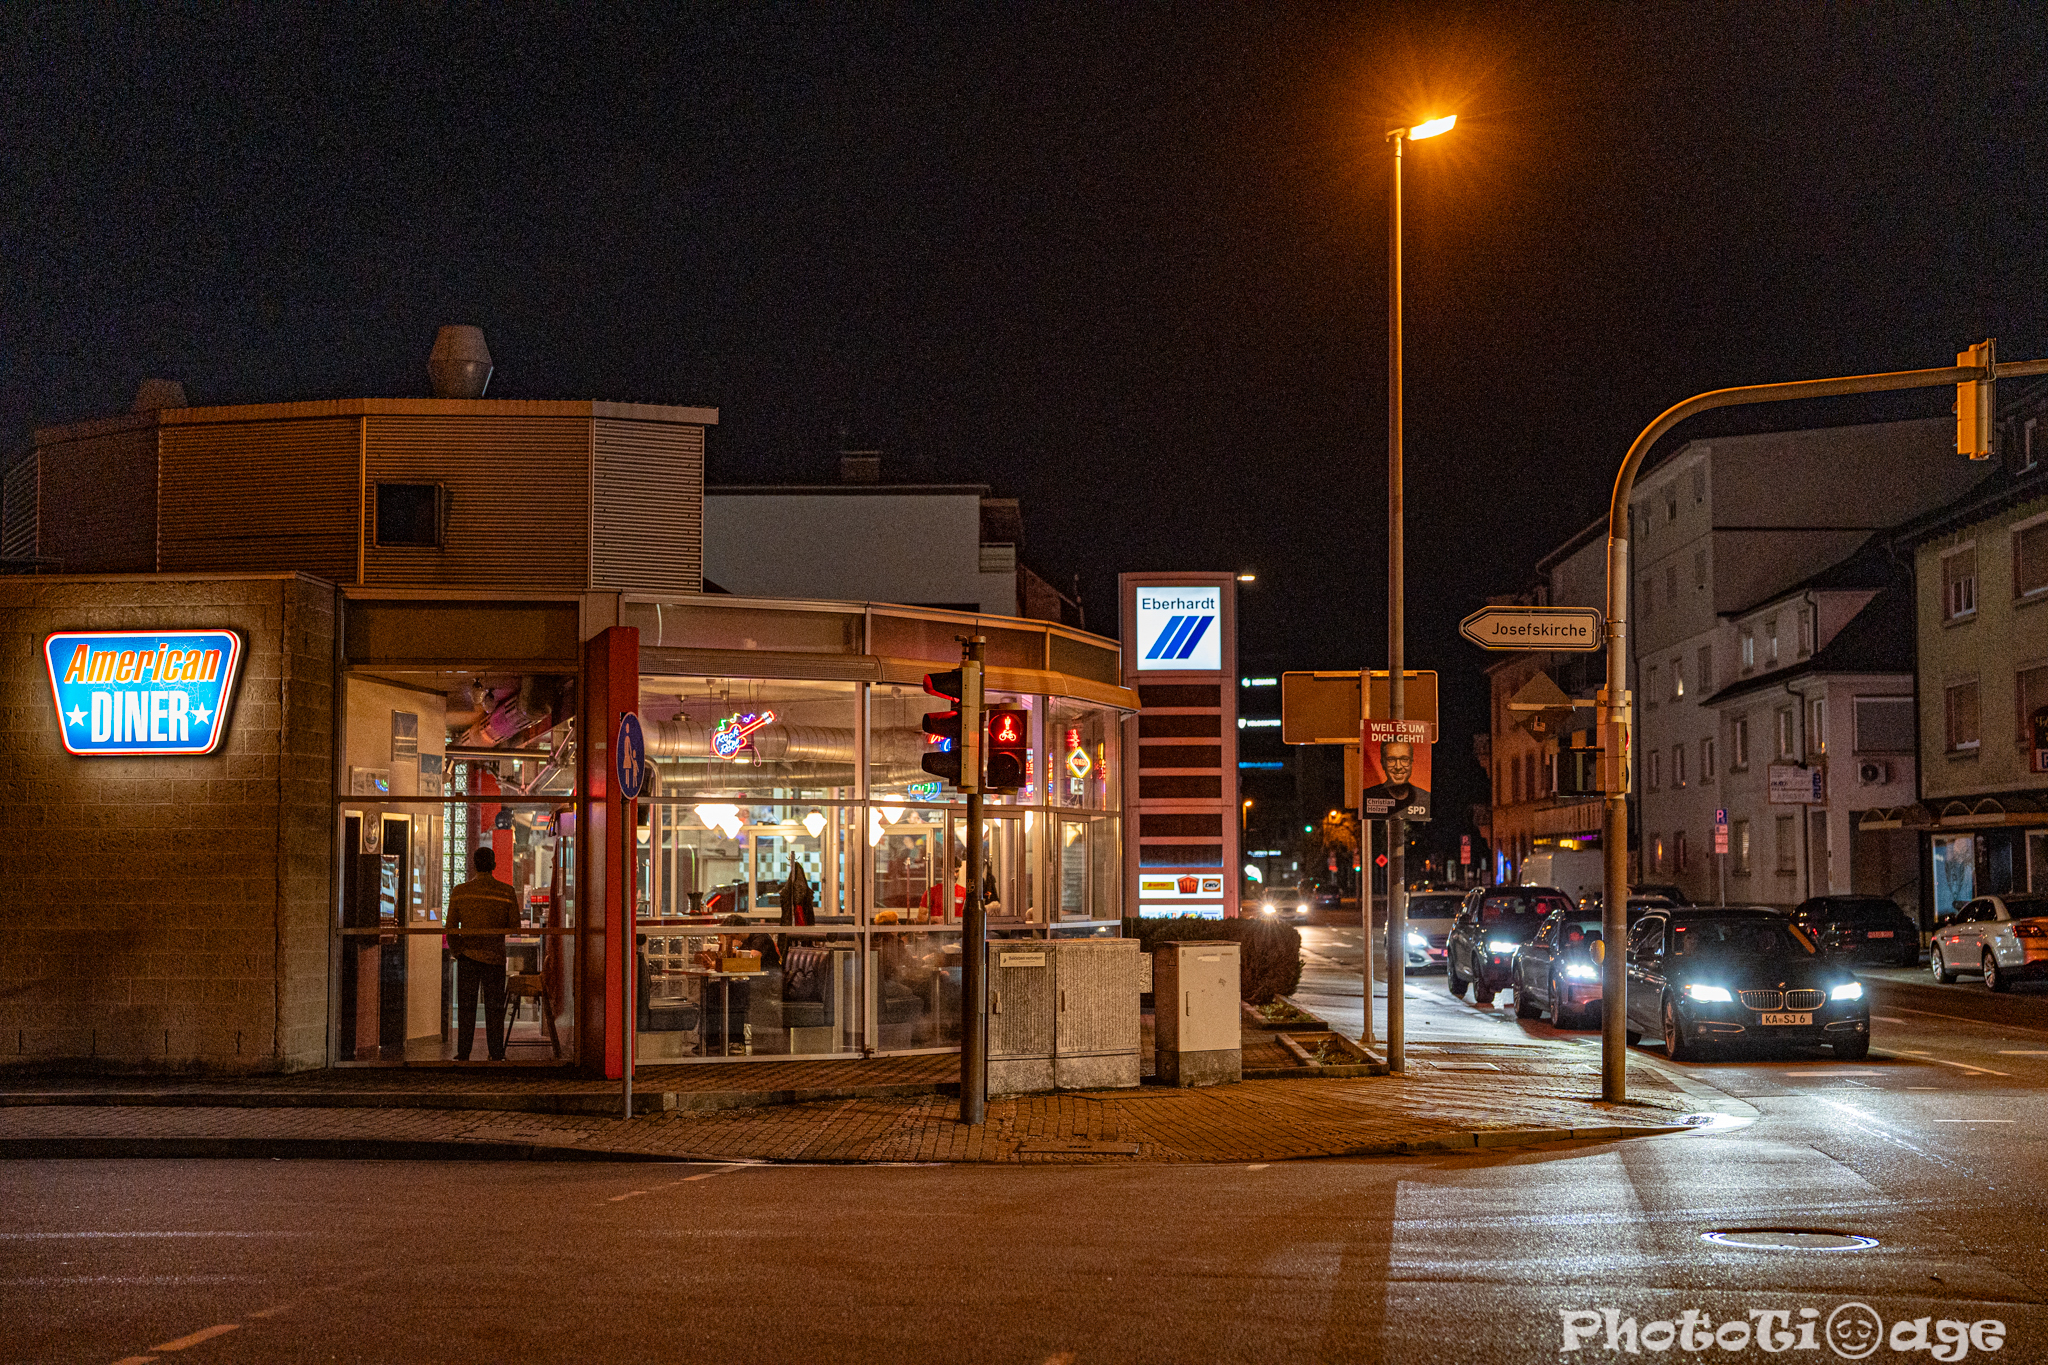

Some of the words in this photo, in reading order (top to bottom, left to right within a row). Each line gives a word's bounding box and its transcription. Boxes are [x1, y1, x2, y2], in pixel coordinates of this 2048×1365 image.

[1142, 597, 1215, 610] Eberhardt
[1491, 622, 1587, 637] Josefskirche
[63, 643, 223, 684] American
[91, 690, 190, 743] DINER
[1370, 723, 1394, 732] WEIL
[1396, 724, 1407, 733] ES
[1408, 724, 1425, 733] UM
[716, 726, 739, 745] Rock
[1371, 733, 1395, 742] DICH
[1396, 734, 1424, 743] GEHT!
[1407, 806, 1426, 815] SPD
[1716, 809, 1725, 823] P
[1765, 1014, 1778, 1024] KA
[1783, 1014, 1796, 1024] SJ
[1799, 1014, 1806, 1024] 6
